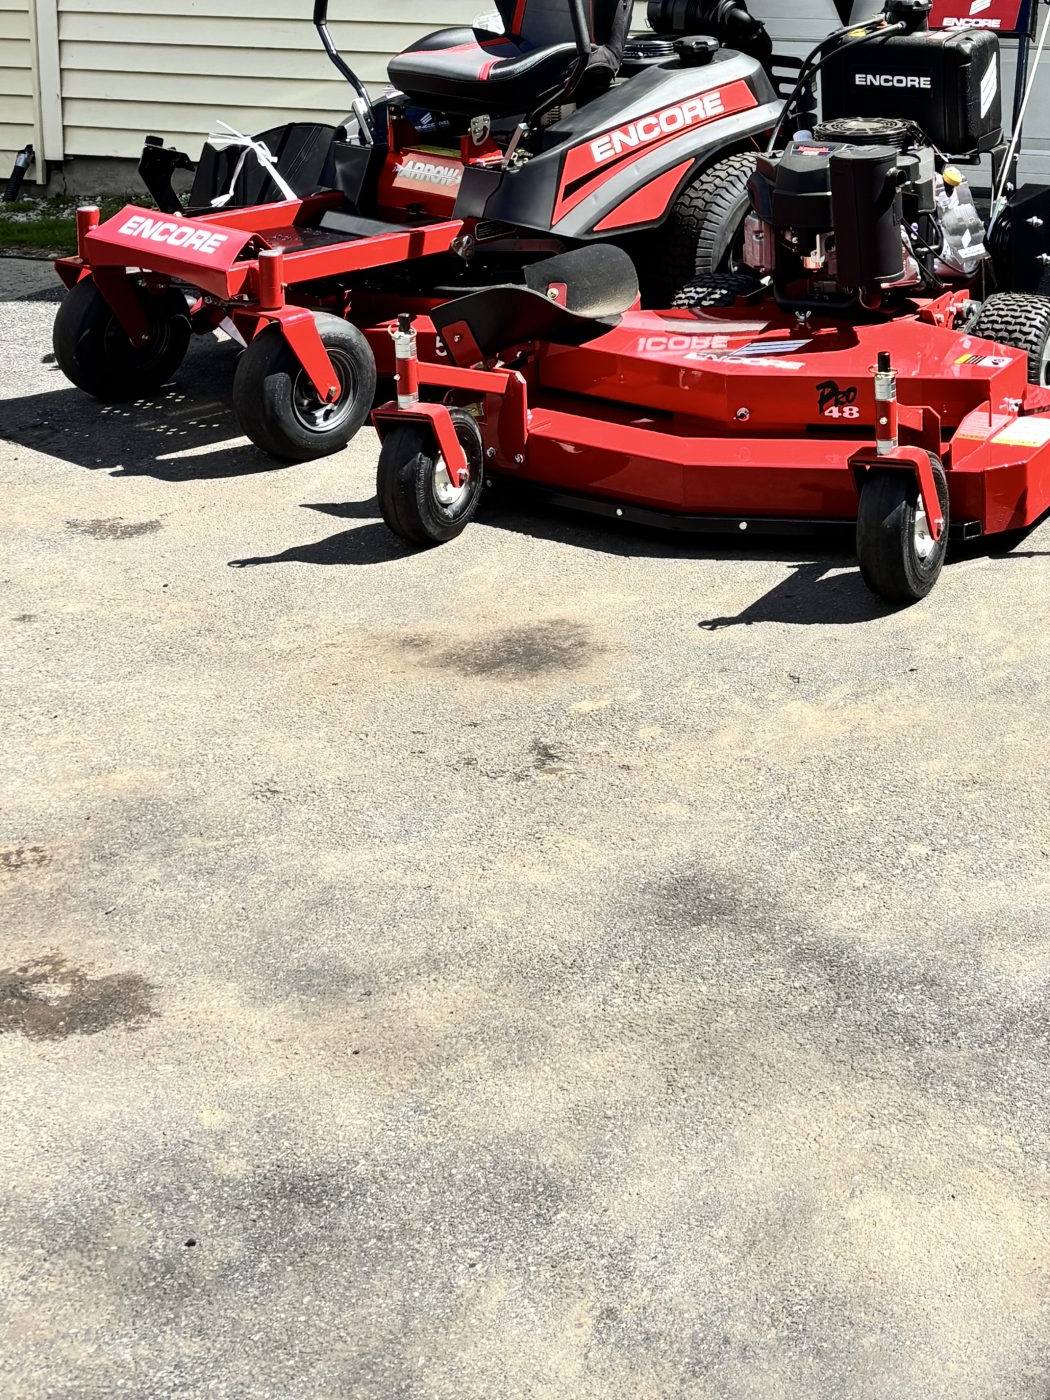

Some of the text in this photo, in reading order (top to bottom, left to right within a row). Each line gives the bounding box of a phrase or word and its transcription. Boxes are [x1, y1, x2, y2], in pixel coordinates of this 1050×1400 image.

[942, 17, 1001, 28] ENCORE
[855, 74, 931, 88] ENCORE
[590, 92, 725, 163] ENCORE
[398, 160, 461, 186] ARROW
[118, 215, 229, 254] ENCORE
[684, 352, 806, 370] ENCORE
[824, 406, 860, 418] 48
